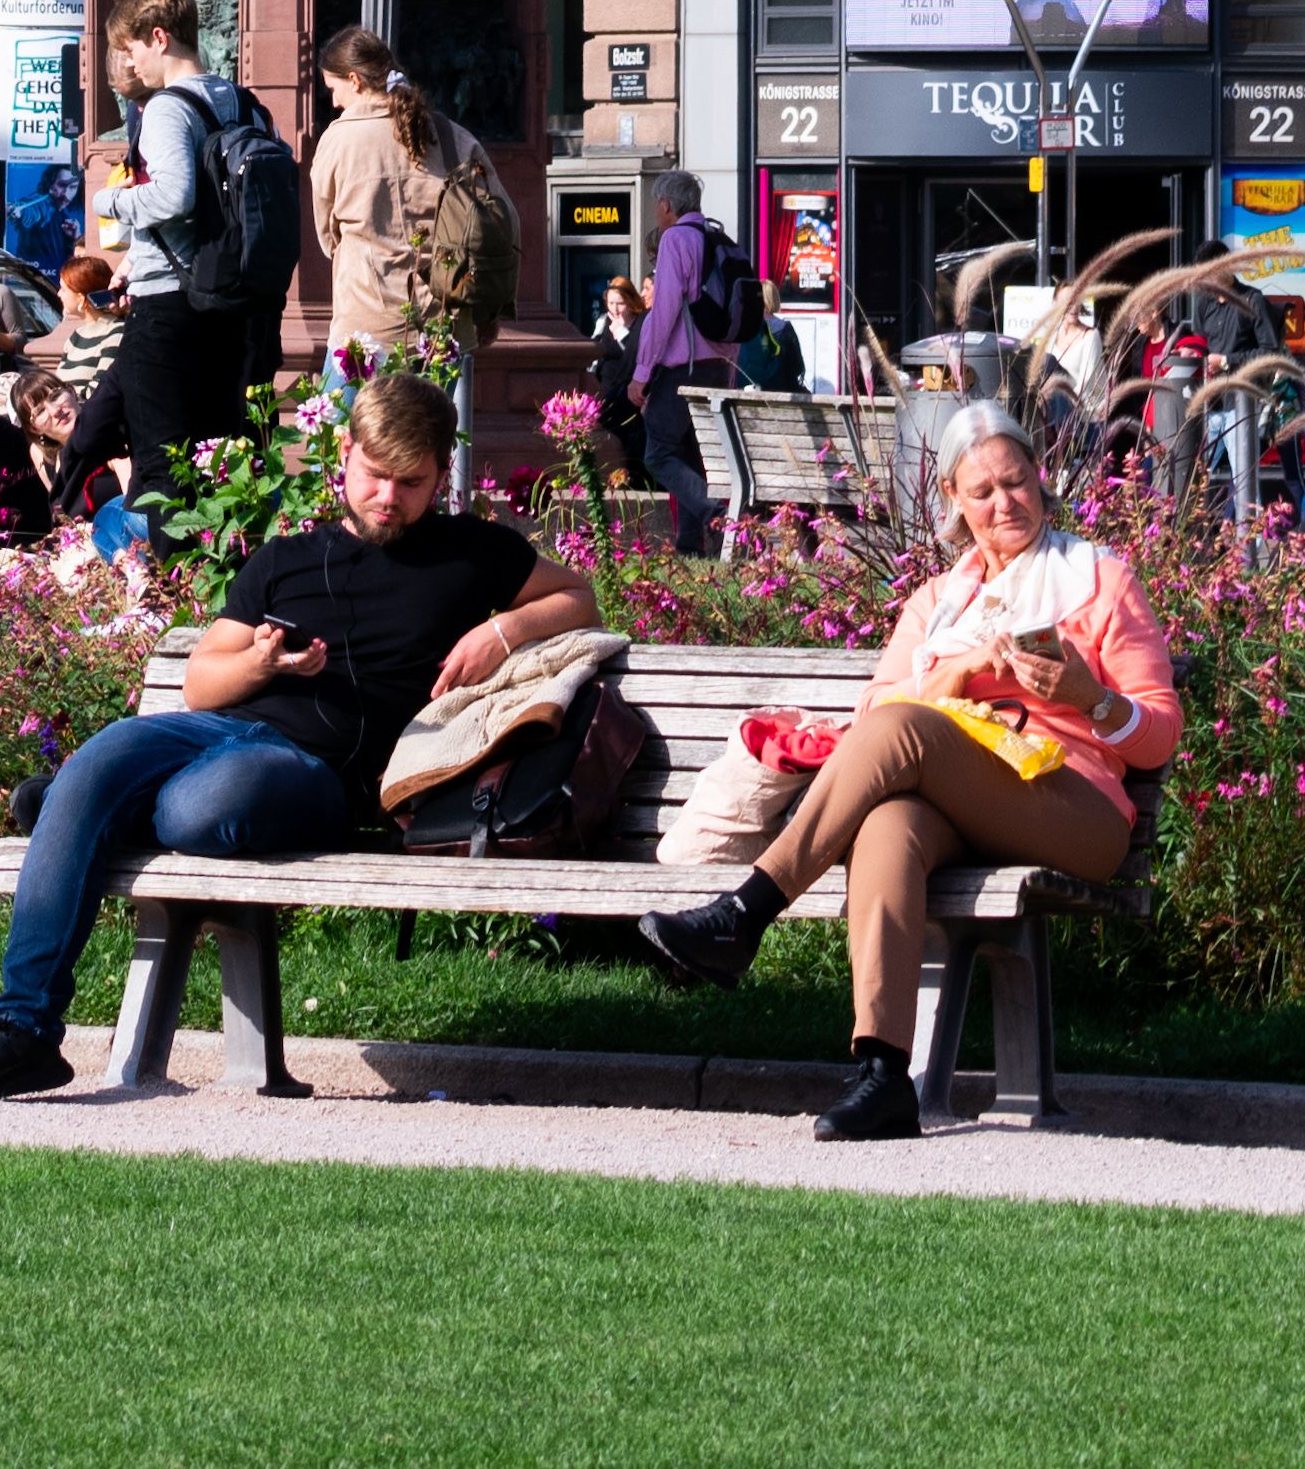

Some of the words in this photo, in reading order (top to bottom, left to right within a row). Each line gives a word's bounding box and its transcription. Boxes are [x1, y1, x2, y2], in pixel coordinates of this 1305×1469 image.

[910, 12, 944, 26] KINO!
[758, 83, 839, 100] KÖNIGSTRASSE
[923, 81, 1103, 114] TEQULA
[780, 106, 819, 143] 22
[1112, 82, 1126, 147] CLUB
[1249, 105, 1295, 143] 22
[1248, 184, 1295, 196] TEQUILA
[573, 206, 620, 224] CINEMA
